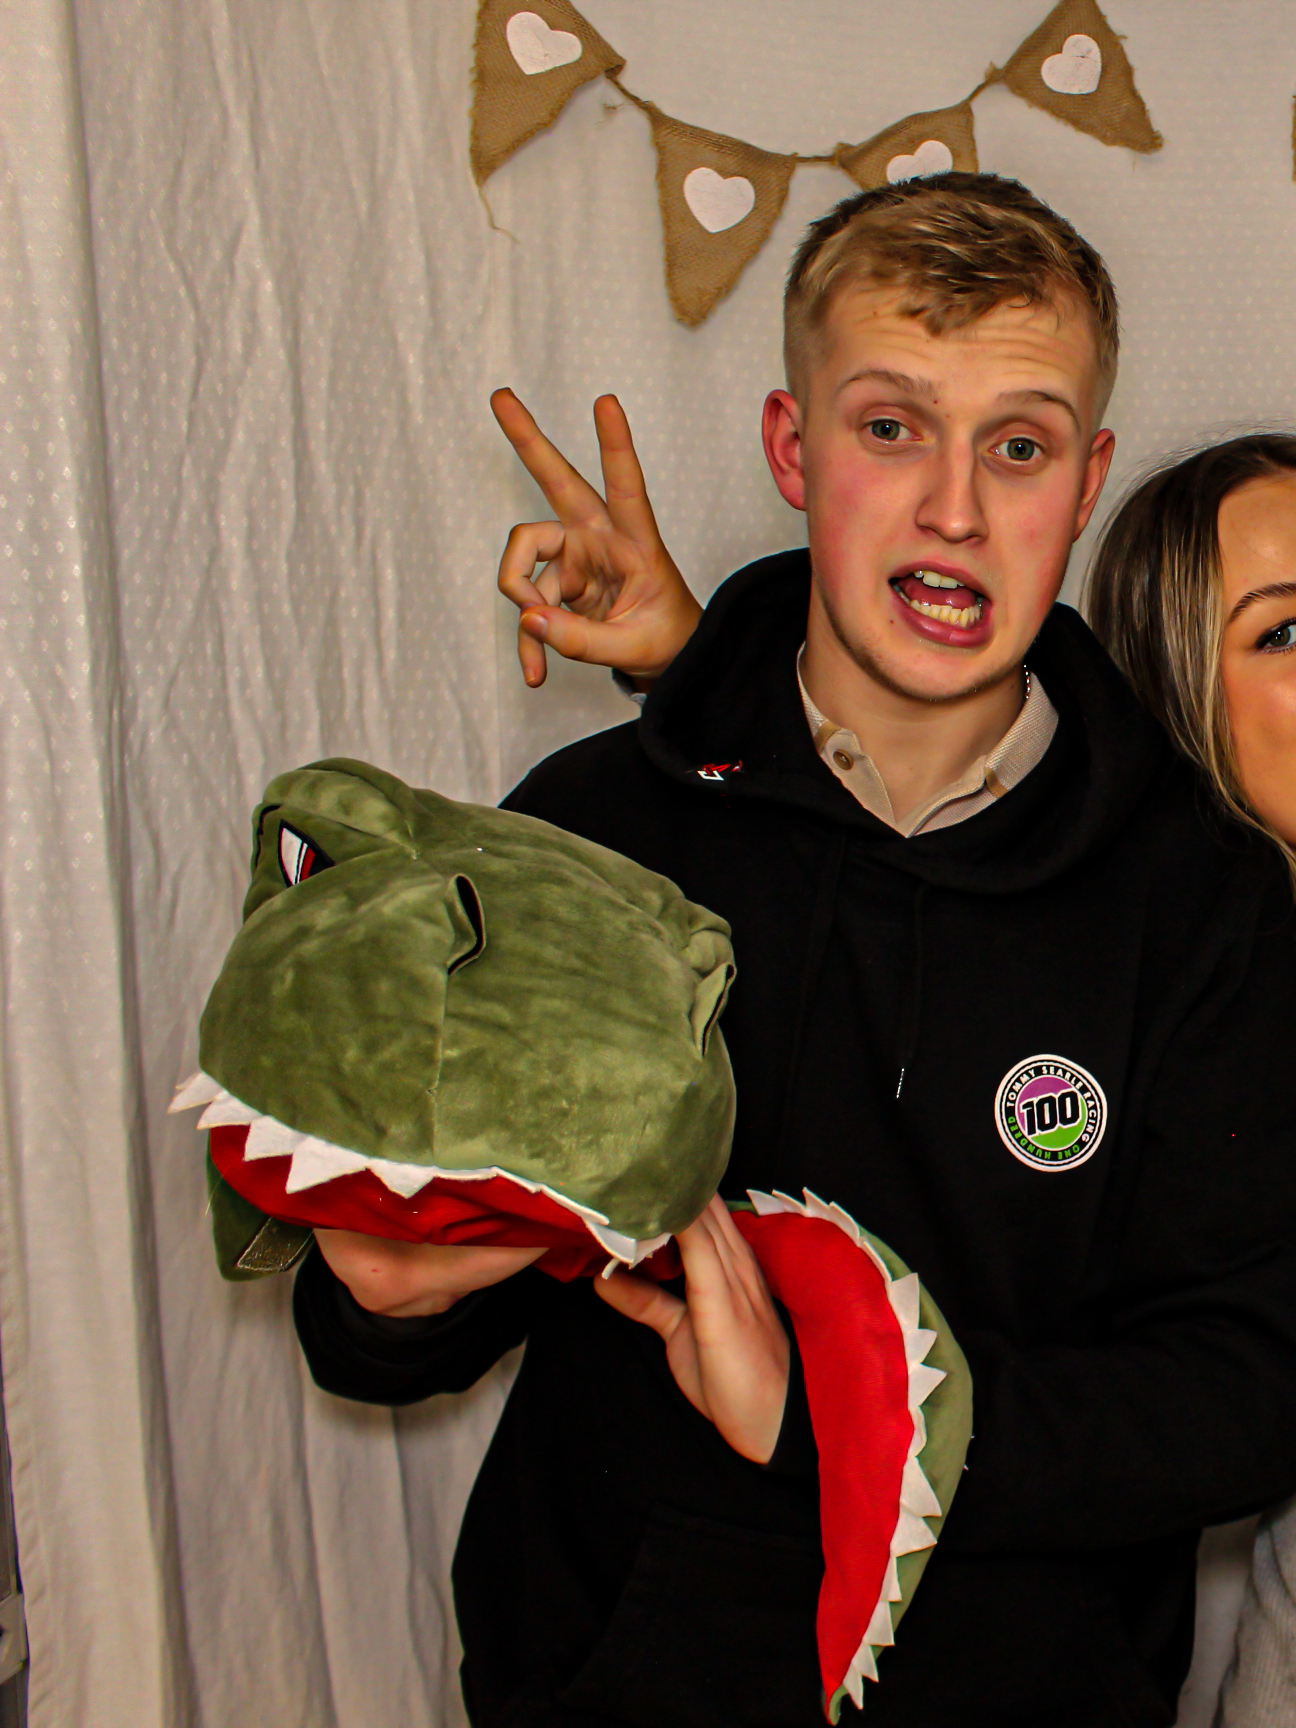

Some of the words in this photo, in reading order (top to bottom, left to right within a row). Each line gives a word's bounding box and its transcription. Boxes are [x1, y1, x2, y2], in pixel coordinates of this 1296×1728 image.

[1006, 1068, 1036, 1108] TOMMY
[1041, 1066, 1084, 1090] SEARLE
[1081, 1092, 1097, 1143] RACING
[1020, 1088, 1081, 1137] 100
[1007, 1116, 1052, 1160] HUNDRED
[1057, 1144, 1081, 1160] ONE
